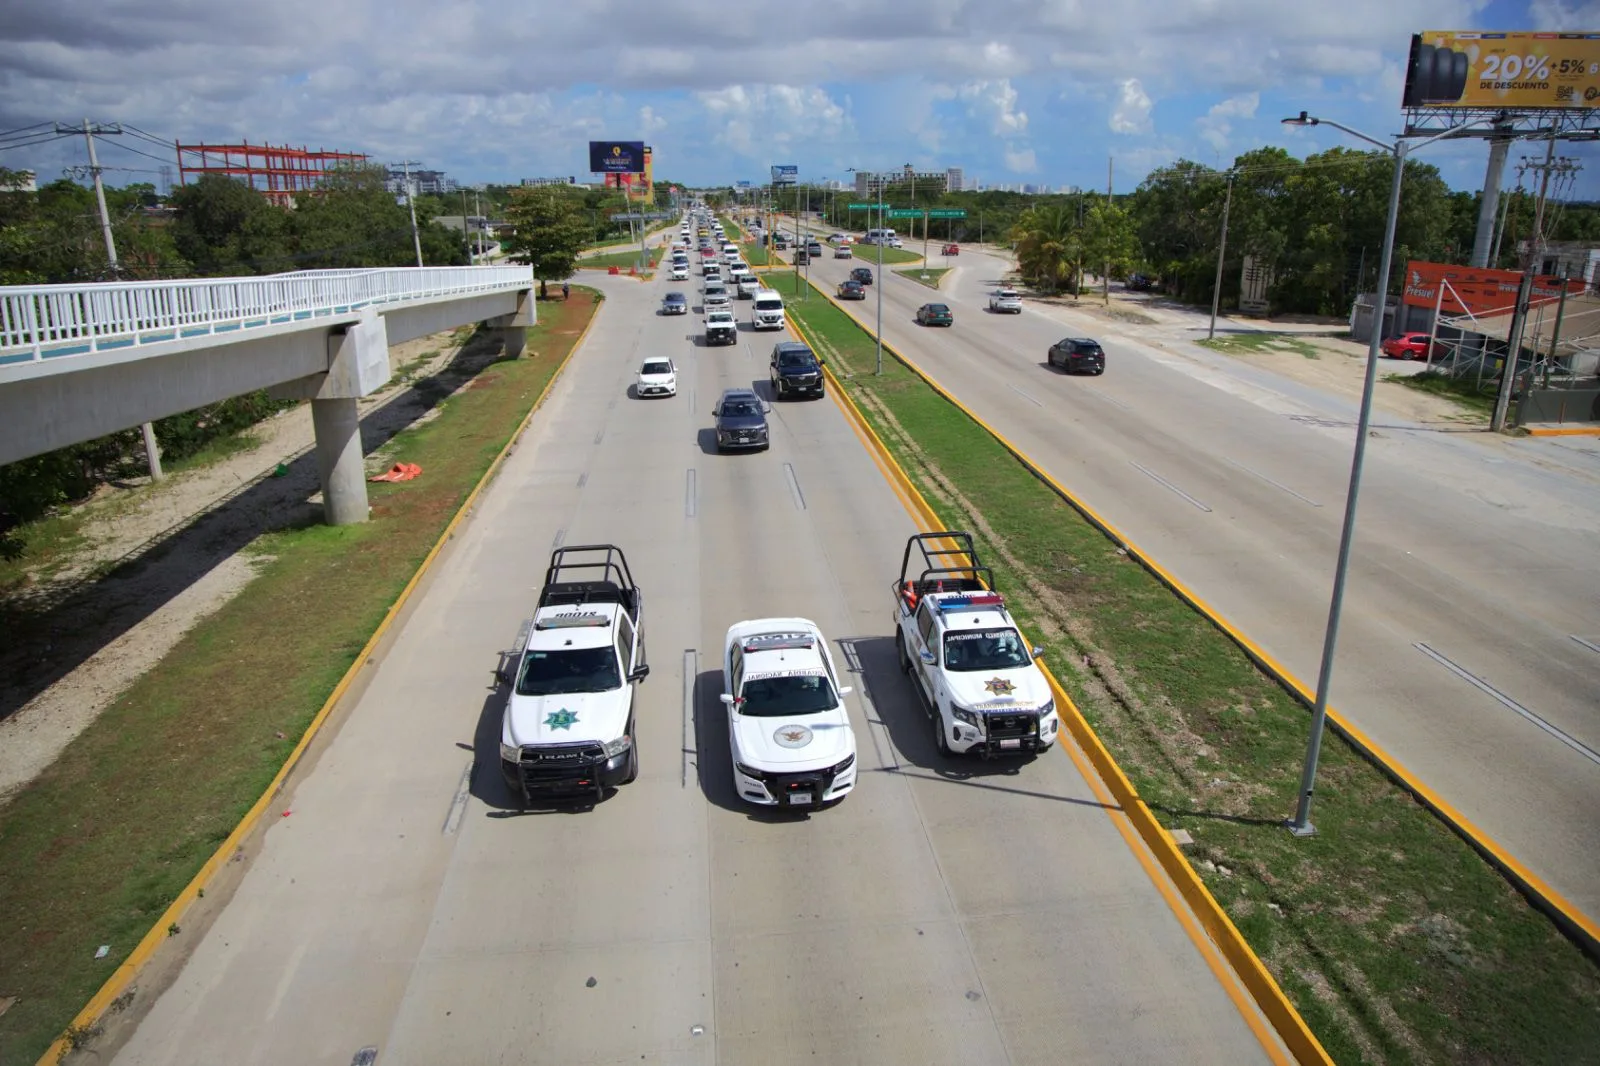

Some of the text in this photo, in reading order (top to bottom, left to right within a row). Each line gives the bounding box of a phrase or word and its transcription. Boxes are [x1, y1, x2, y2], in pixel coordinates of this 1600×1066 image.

[1480, 55, 1550, 80] 20%
[1479, 81, 1549, 90] DE DESCUENTO
